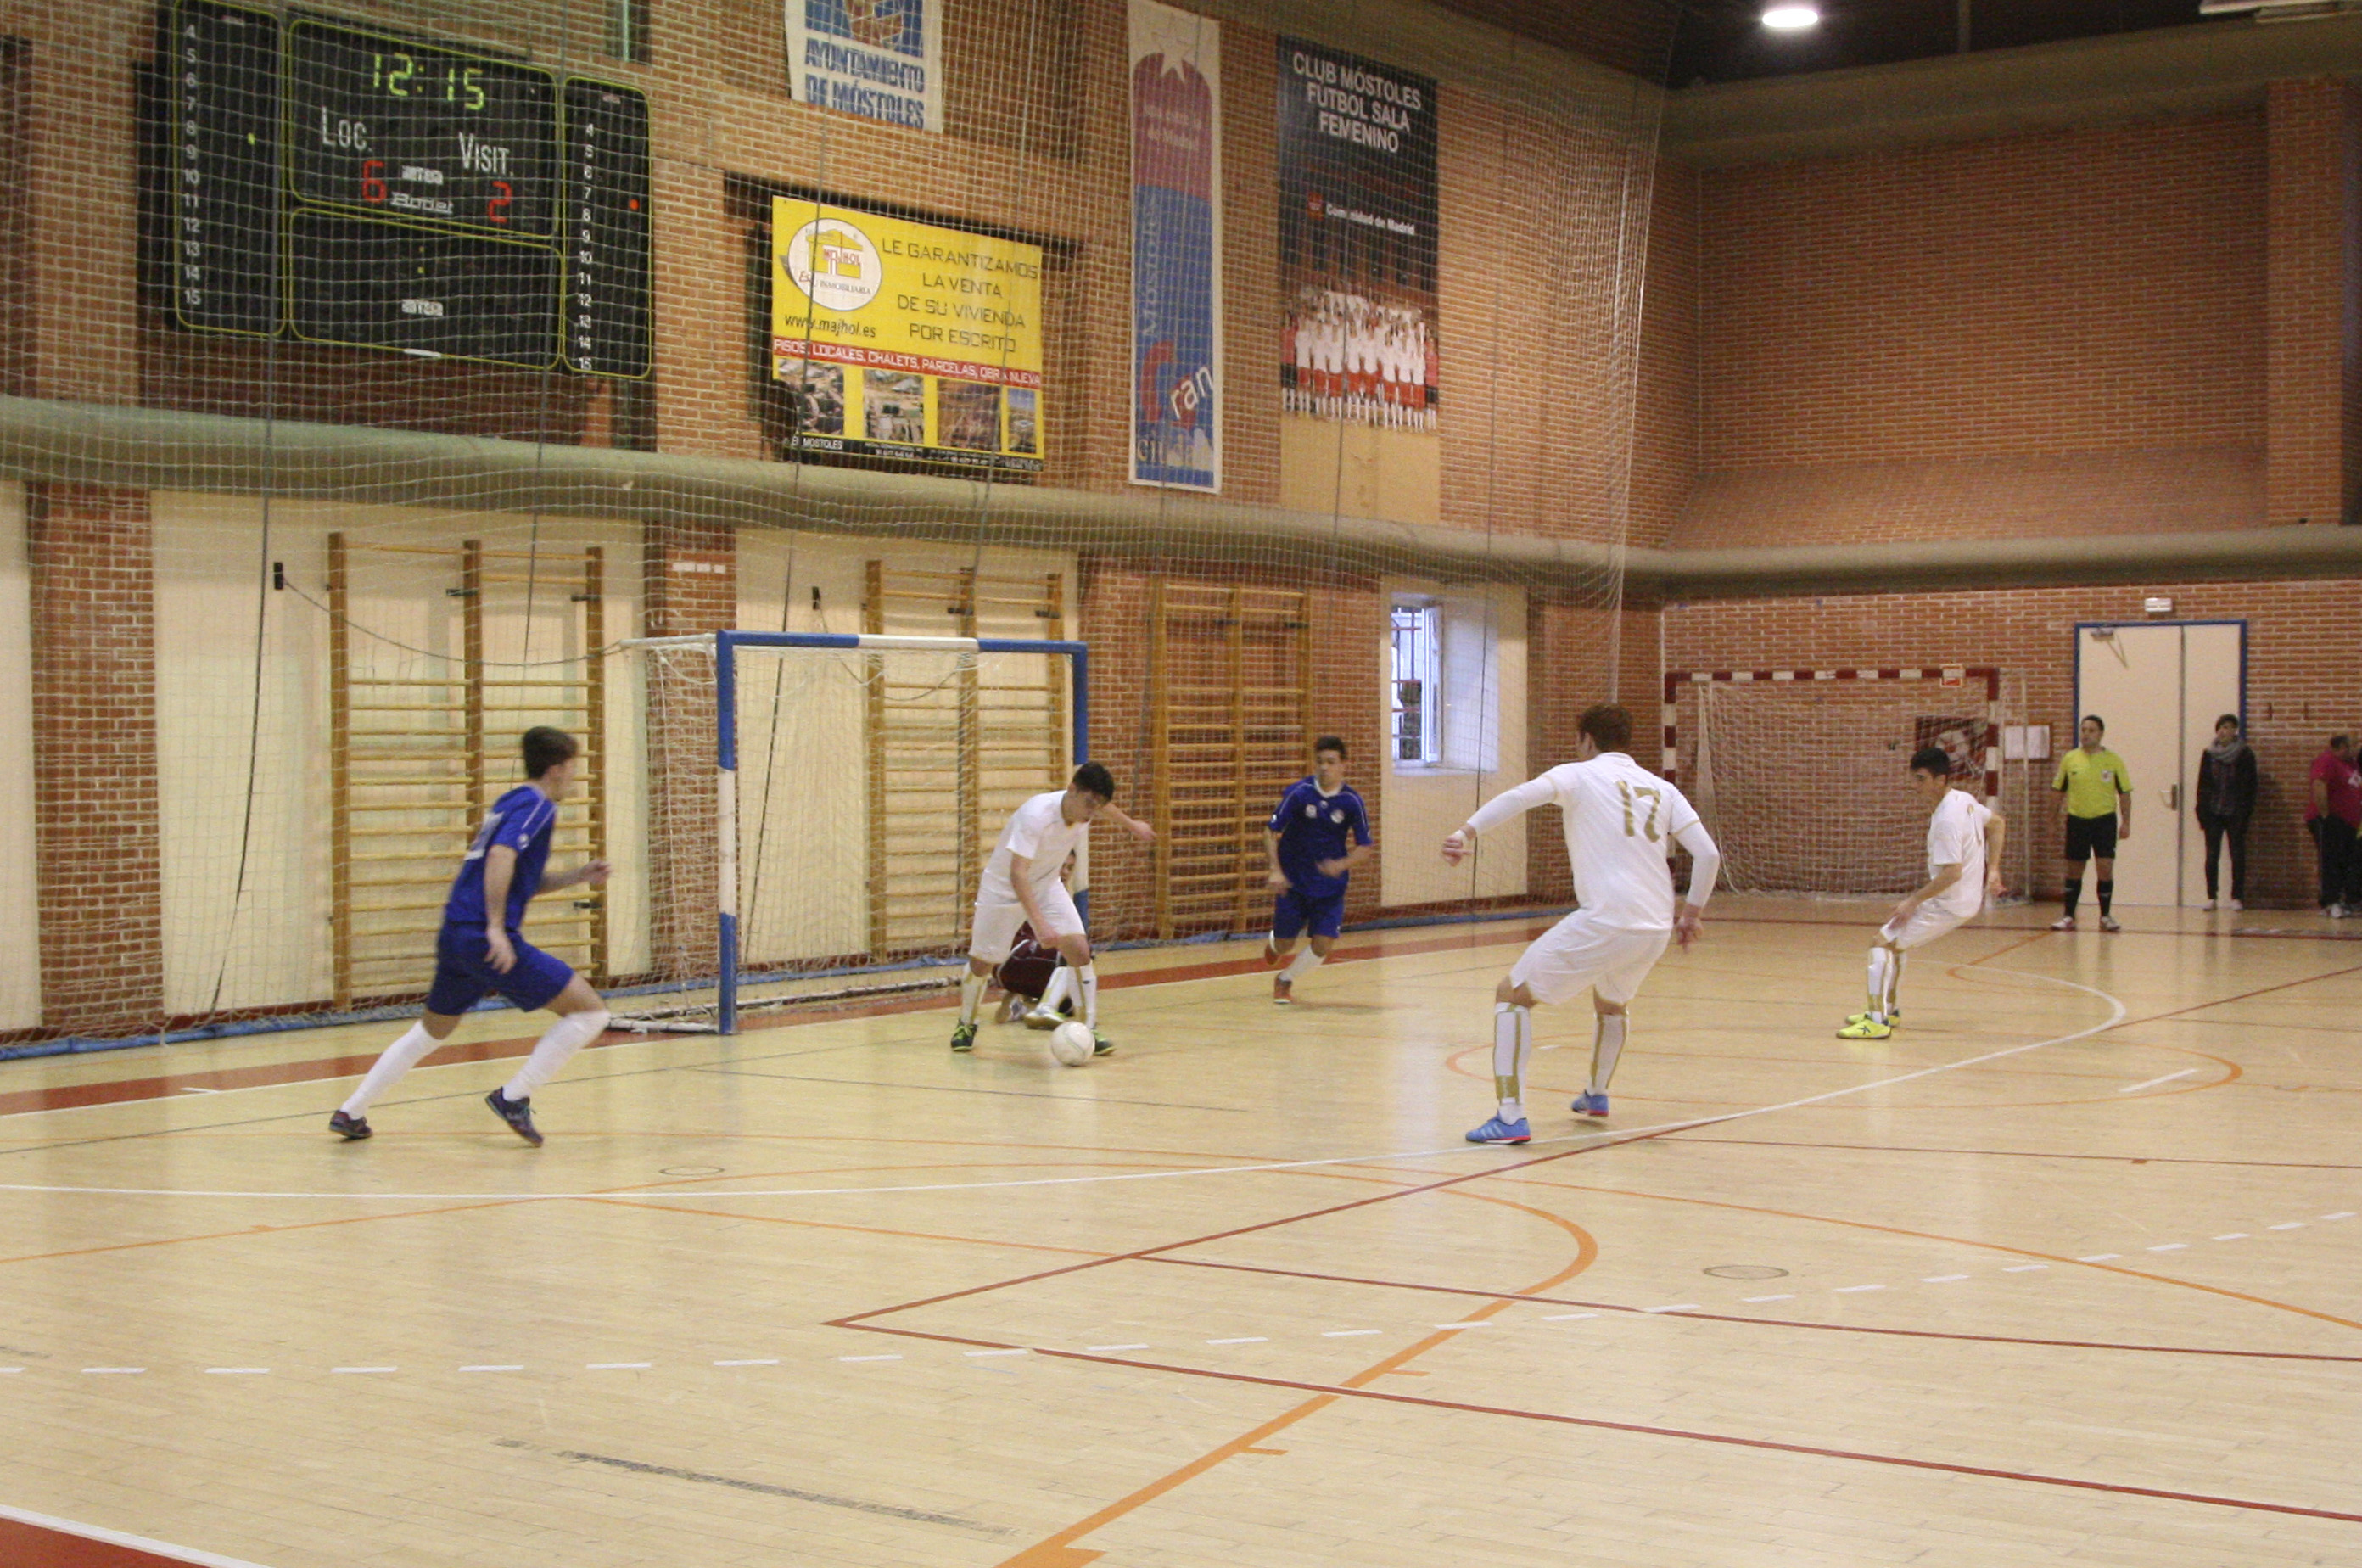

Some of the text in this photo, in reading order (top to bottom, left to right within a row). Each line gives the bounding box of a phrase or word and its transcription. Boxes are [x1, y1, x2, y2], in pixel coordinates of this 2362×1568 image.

[184, 24, 196, 38] 4
[186, 48, 197, 64] 5
[805, 37, 925, 94] AYUNTAMIENTO
[186, 72, 197, 88] 6
[373, 52, 484, 110] 12:15
[1293, 53, 1422, 110] CLUB MÓSTOLES
[186, 96, 196, 111] 7
[805, 73, 924, 128] DE MÓSTOLES
[1372, 100, 1411, 133] SALA
[186, 120, 197, 136] 8
[585, 123, 593, 137] 4
[1319, 111, 1400, 153] FEMENINO
[185, 144, 197, 160] 9
[585, 144, 593, 158] 5
[183, 169, 200, 184] 10
[584, 165, 592, 180] 6
[362, 160, 387, 203] 6
[184, 192, 199, 208] 11
[584, 186, 591, 199] 7
[488, 180, 512, 223] 2
[582, 208, 591, 222] 8
[1326, 203, 1374, 226] Comnidad
[183, 216, 200, 233] 12
[582, 229, 590, 243] 9
[184, 241, 200, 257] 13
[579, 250, 592, 265] 10
[882, 238, 1038, 279] LE GARANTIZAMOS
[184, 266, 200, 281] 14
[579, 272, 591, 286] 11
[923, 272, 1003, 298] LA VENTA
[184, 289, 201, 305] 15
[579, 294, 592, 308] 12
[898, 294, 1026, 328] DE SU VIVIENDA
[579, 315, 592, 329] 13
[785, 315, 876, 338] www.majhol.es
[579, 335, 591, 350] 14
[910, 323, 1016, 353] POR ESCRITO
[579, 357, 592, 370] 15
[813, 344, 866, 363] LOCALES,
[868, 350, 920, 370] CHALETS,
[922, 358, 978, 380] PARCELAS,
[1009, 371, 1042, 385] NUEVA
[1615, 780, 1662, 843] 17
